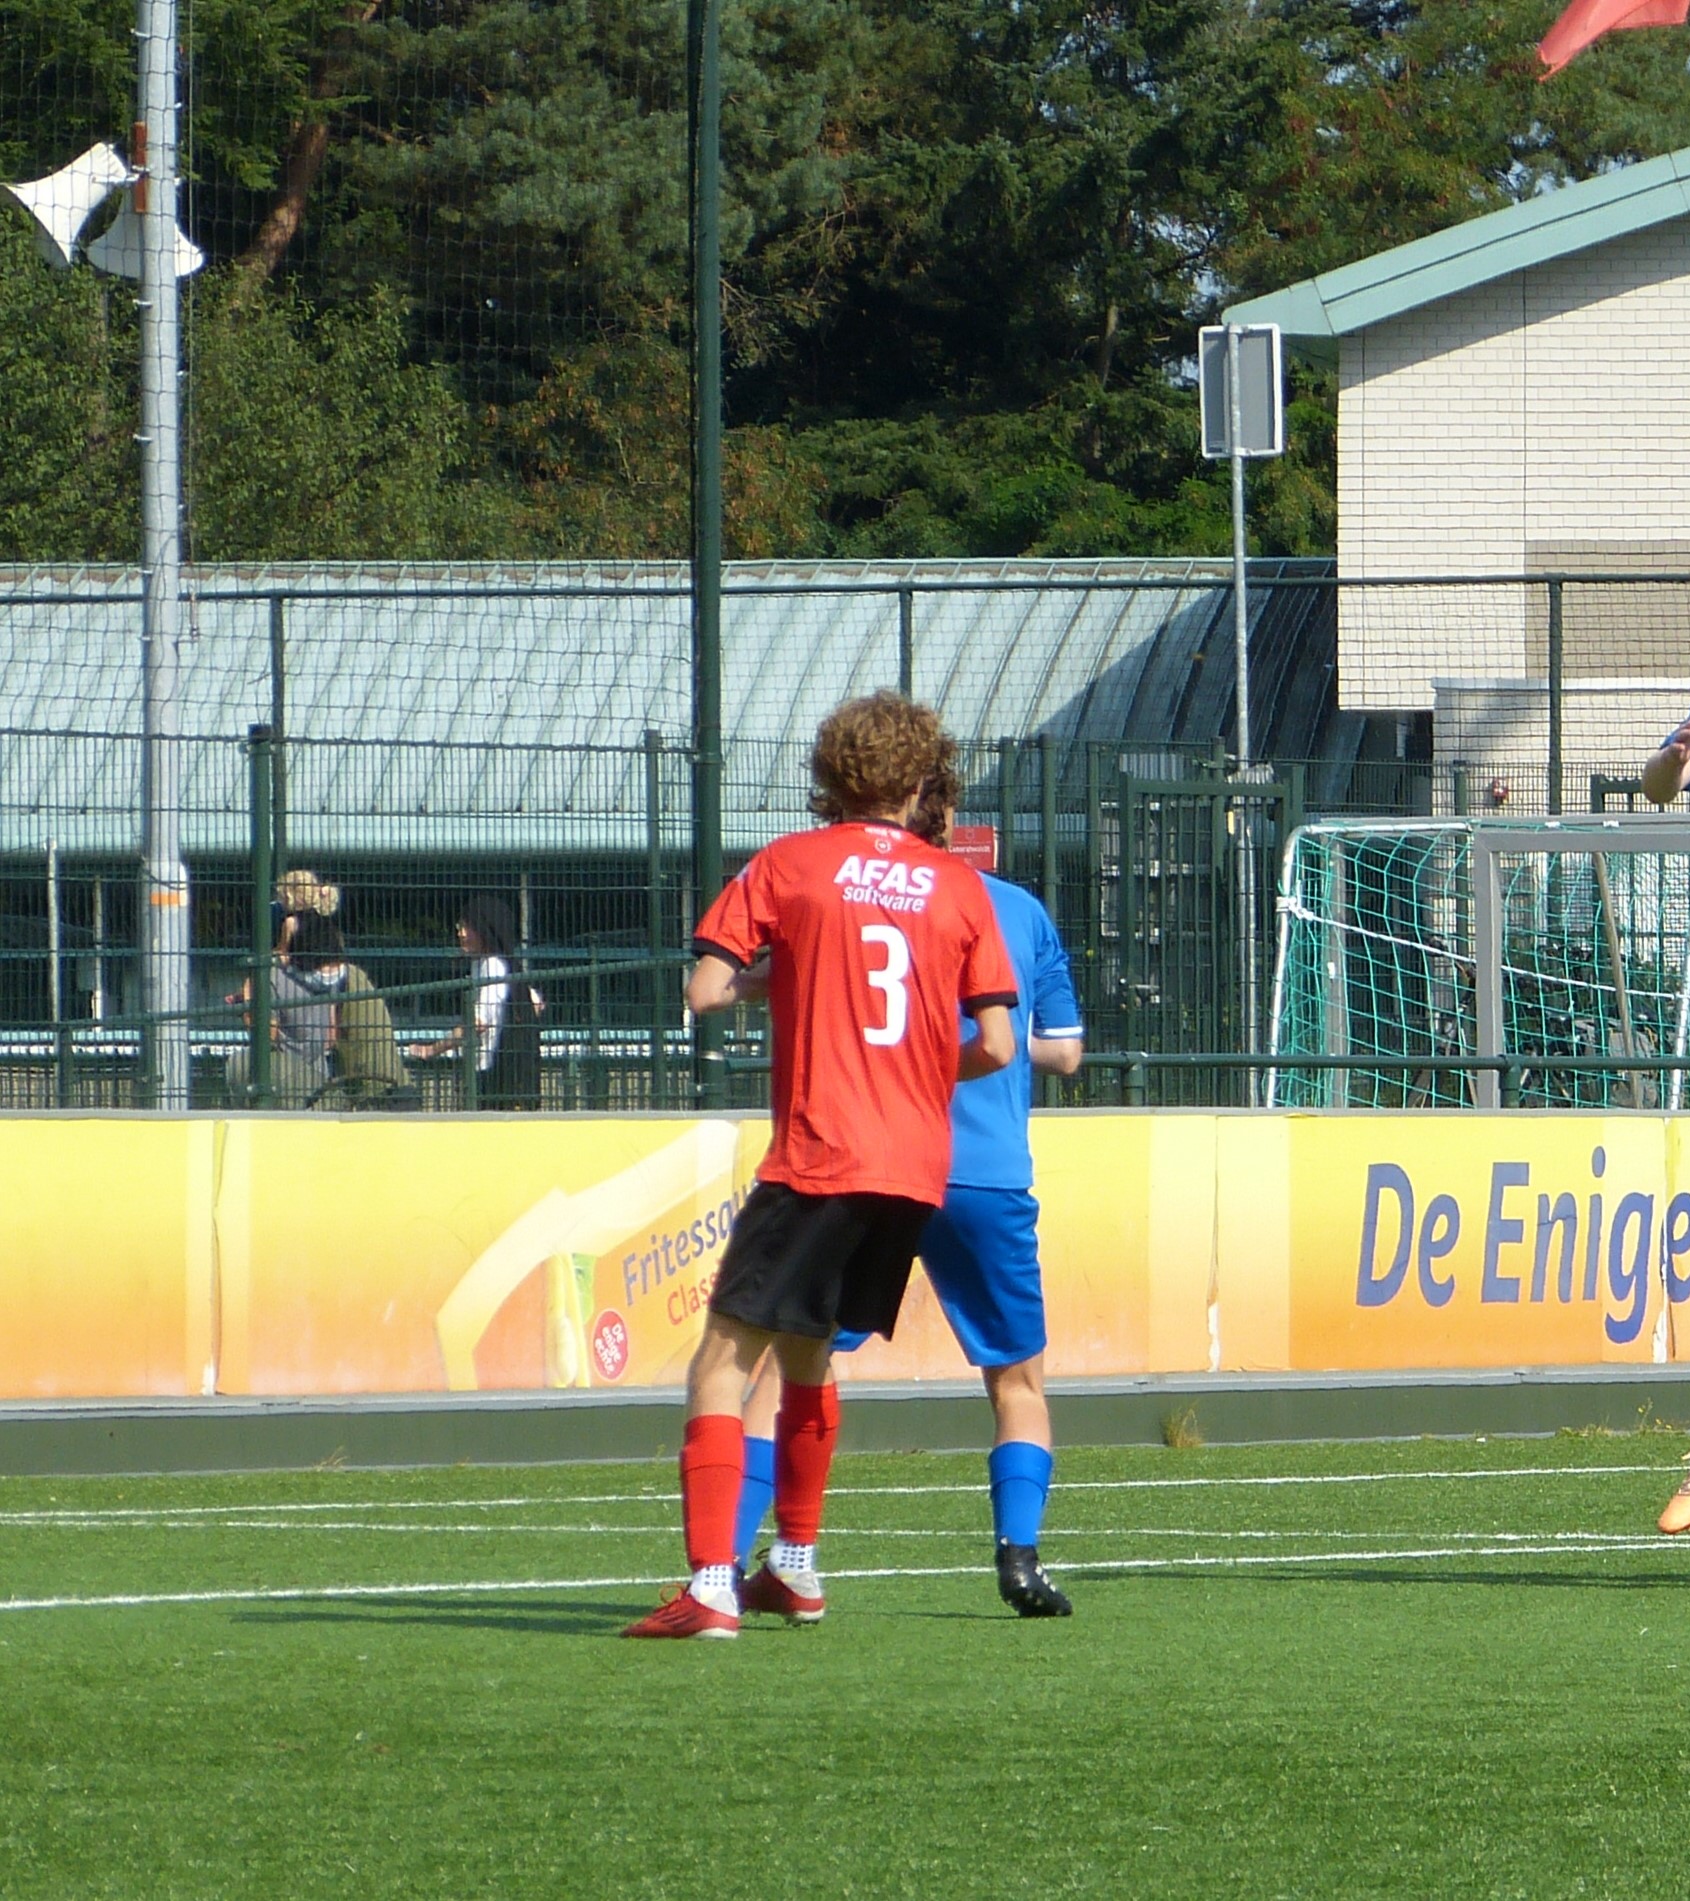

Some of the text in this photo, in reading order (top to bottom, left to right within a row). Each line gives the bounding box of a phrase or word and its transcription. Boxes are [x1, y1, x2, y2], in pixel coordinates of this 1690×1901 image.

[833, 855, 936, 896] AFAS
[842, 884, 925, 913] software
[861, 925, 910, 1045] 3
[1356, 1163, 1460, 1307] De
